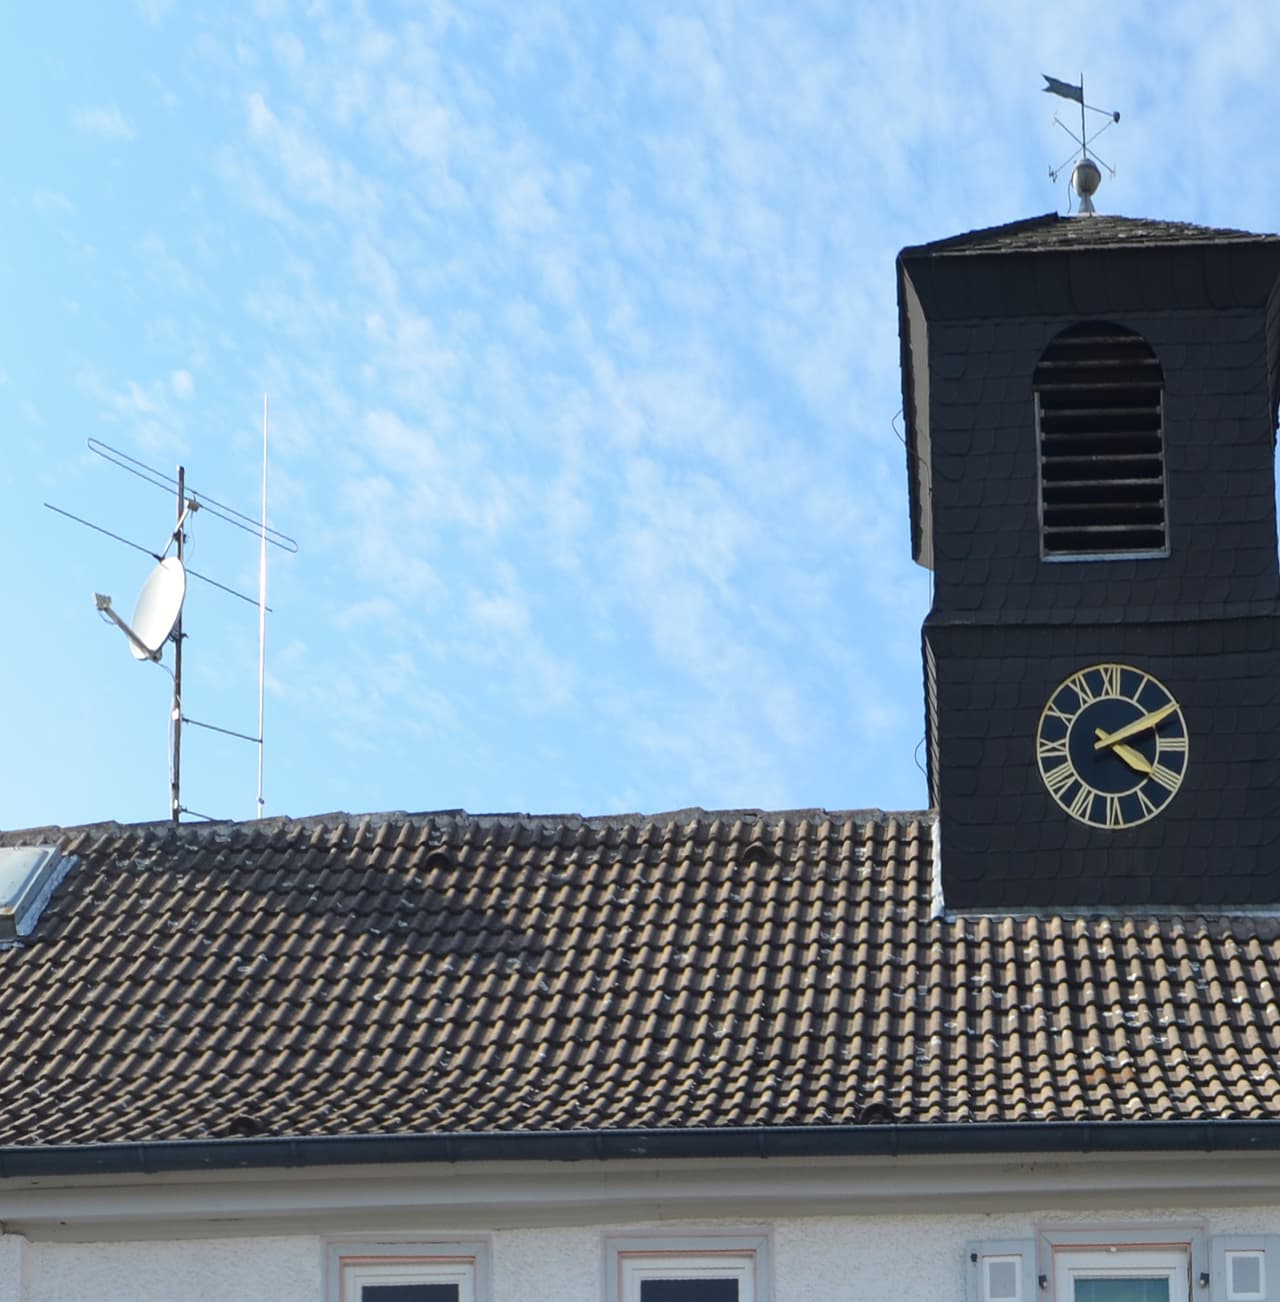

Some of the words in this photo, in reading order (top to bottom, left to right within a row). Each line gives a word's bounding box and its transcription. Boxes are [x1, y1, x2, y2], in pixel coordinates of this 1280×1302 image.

[1066, 673, 1094, 706] XI
[1099, 665, 1120, 698] XII
[1132, 675, 1150, 703] I
[1046, 701, 1075, 727] X
[1038, 737, 1068, 757] IX
[1157, 737, 1187, 752] III
[1043, 761, 1076, 800] VIII
[1069, 784, 1095, 822] VII
[1106, 795, 1124, 827] VI
[1135, 787, 1158, 818] V
